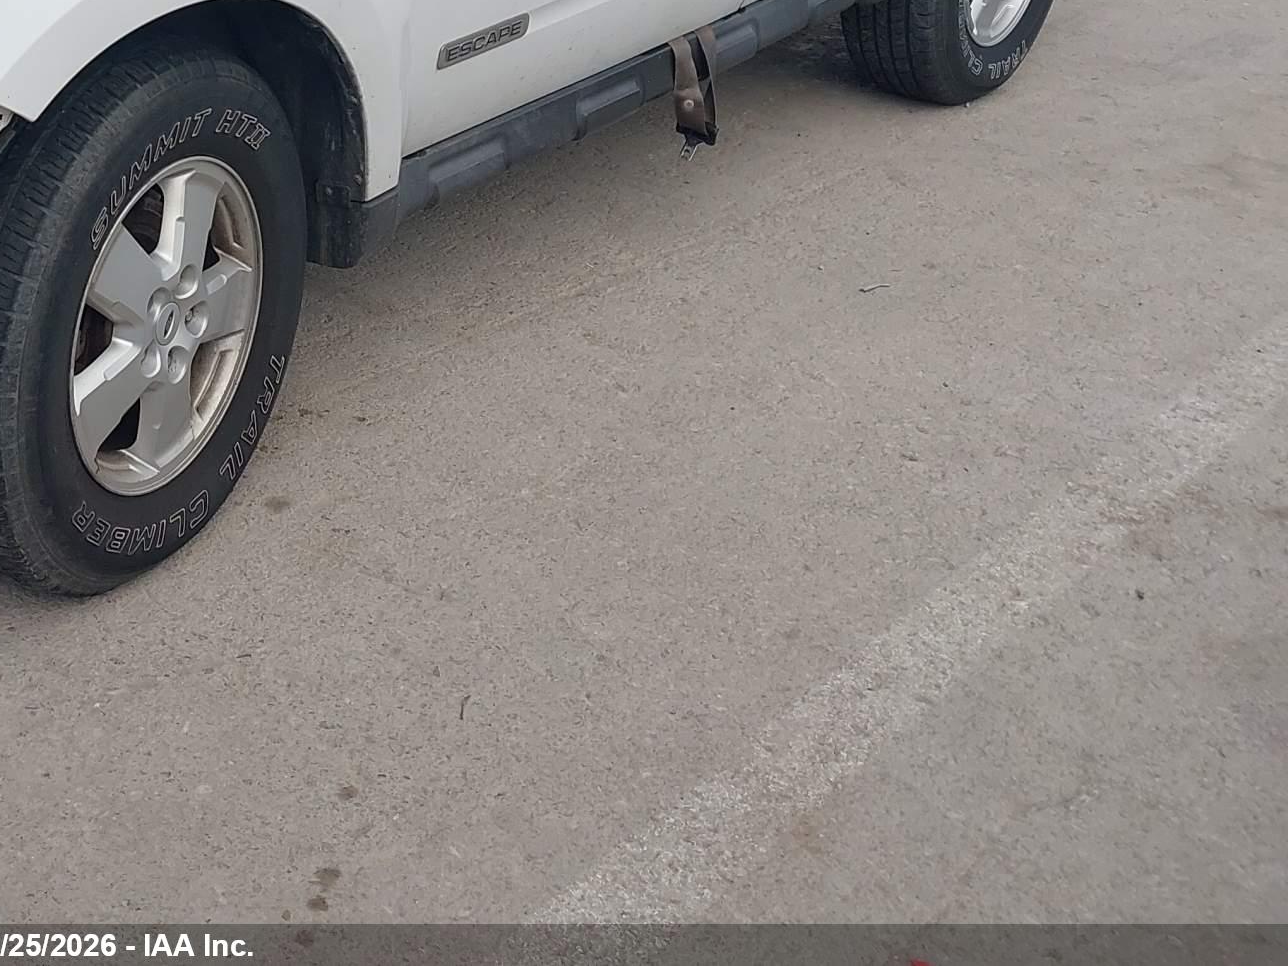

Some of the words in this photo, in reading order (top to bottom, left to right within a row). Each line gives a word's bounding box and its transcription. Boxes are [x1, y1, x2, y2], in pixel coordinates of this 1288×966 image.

[447, 20, 523, 62] ESCAPE
[90, 107, 212, 250] SUMMIT
[219, 355, 285, 480] TRAIL
[72, 489, 209, 556] CLIMBER
